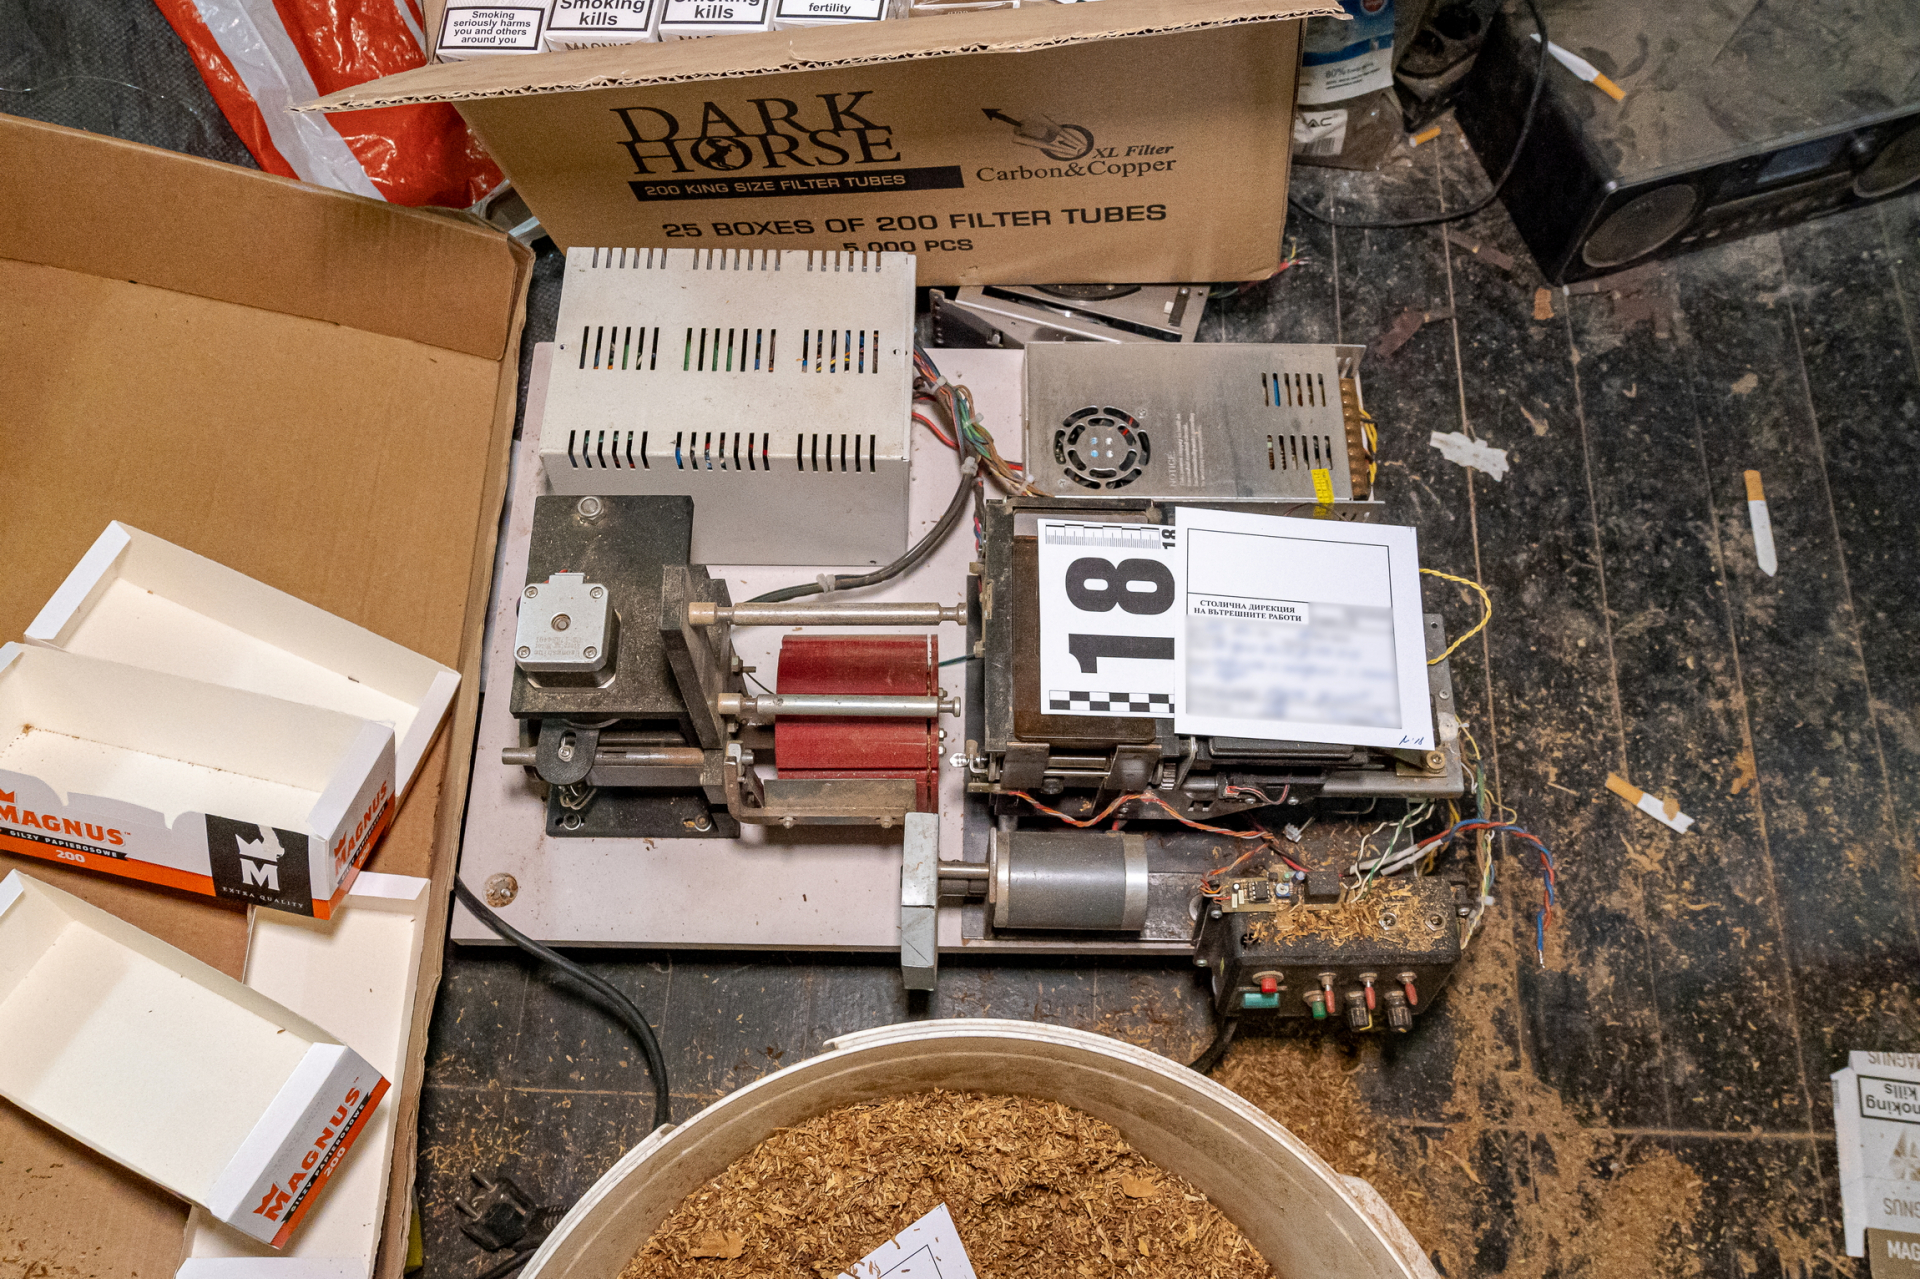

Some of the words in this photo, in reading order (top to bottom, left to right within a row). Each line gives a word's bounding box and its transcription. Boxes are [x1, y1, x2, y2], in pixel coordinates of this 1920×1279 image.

[560, 0, 645, 13] Smoking
[694, 5, 734, 19] kills
[808, 3, 851, 14] fertility
[472, 11, 515, 20] Smoking
[579, 12, 618, 26] kills
[453, 19, 497, 29] seriously
[454, 28, 472, 36] you
[475, 27, 493, 35] and
[498, 37, 517, 45] you
[609, 90, 893, 142] DARK
[616, 125, 902, 174] HORSE
[1092, 148, 1119, 160] XL
[1125, 145, 1175, 157] Filter
[976, 159, 1177, 182] Carbon&Copper
[645, 184, 681, 196] 200
[686, 182, 730, 195] KING
[734, 181, 775, 192] SIZE
[780, 177, 841, 190] FILTER
[845, 174, 906, 188] TUBES
[662, 223, 703, 237] 25
[712, 219, 815, 236] BOXES
[825, 217, 865, 234] OF
[876, 214, 938, 231] 200
[950, 209, 1052, 229] FILTER
[1061, 204, 1168, 224] TUBES
[924, 239, 974, 252] PCS
[1200, 599, 1247, 610] СТОЛИЧНА
[1248, 603, 1295, 614] ДИРЕКЦИЯ
[1065, 557, 1176, 674] 18
[1194, 607, 1206, 615] НА
[1208, 608, 1267, 620] ВЪТРЕШНИТЕ
[1268, 613, 1302, 622] РАБОТИ
[9, 830, 39, 841] GILZY
[45, 837, 118, 858] PAPIEROSOWE
[55, 849, 86, 863] 200
[240, 857, 280, 891] M
[222, 886, 255, 898] EXTRA
[259, 895, 303, 908] QUALITY
[1884, 1083, 1917, 1101] kills
[263, 1087, 361, 1222] MAGNUS
[323, 1147, 346, 1178] 200
